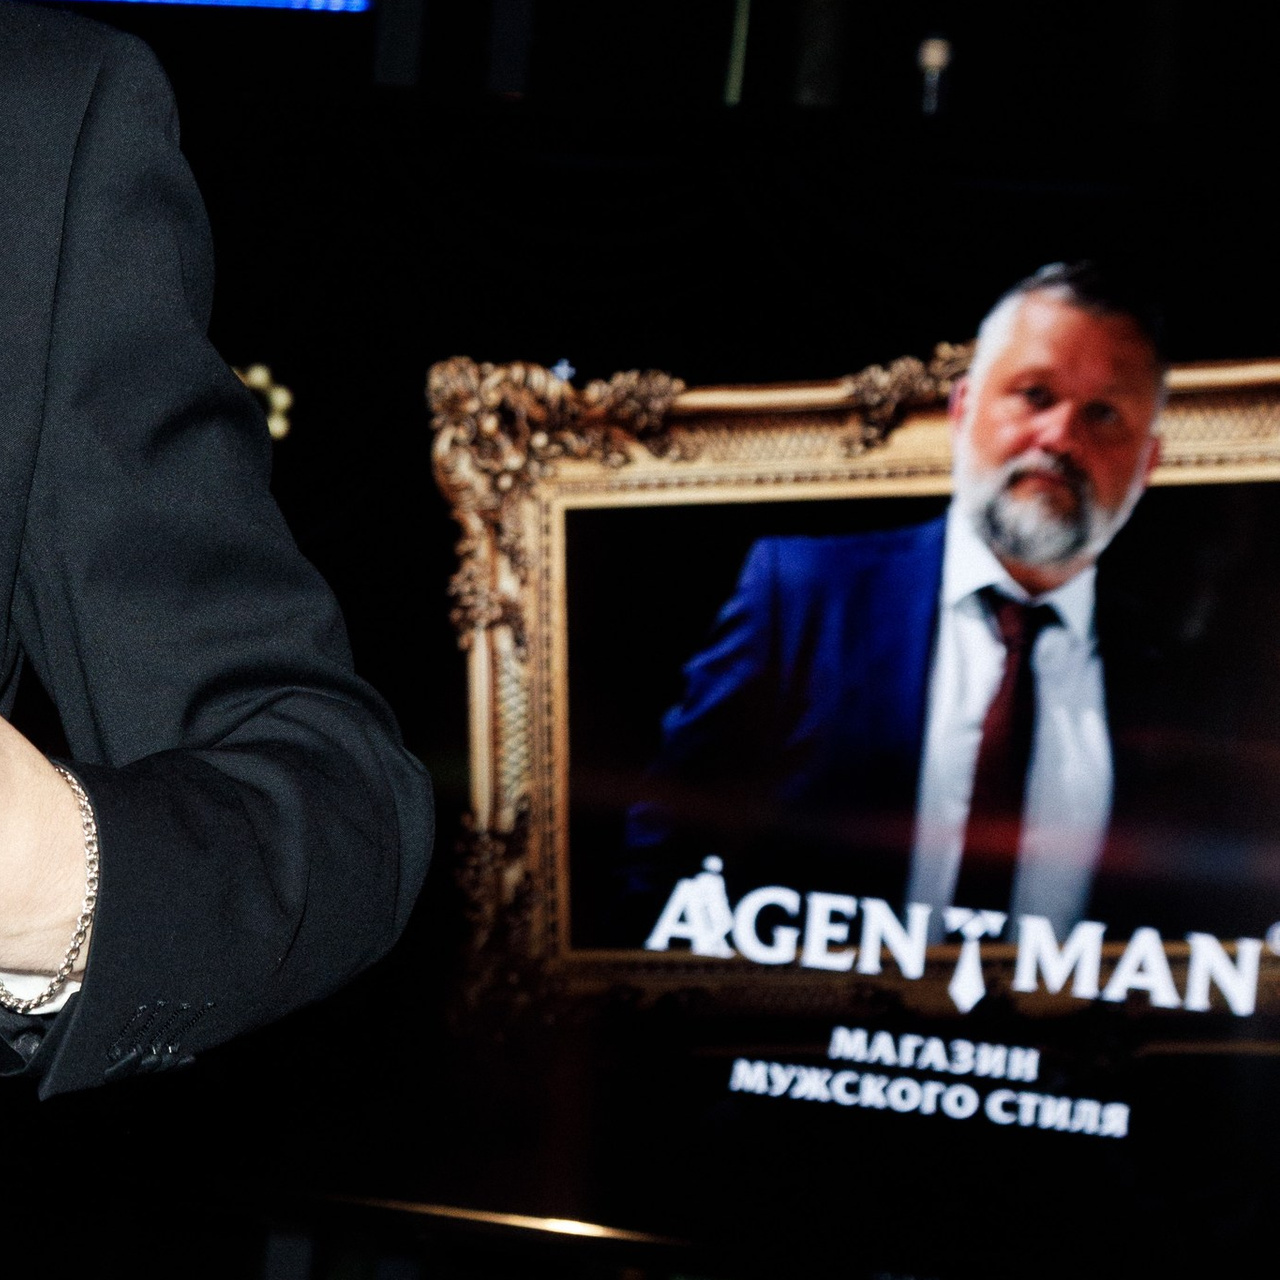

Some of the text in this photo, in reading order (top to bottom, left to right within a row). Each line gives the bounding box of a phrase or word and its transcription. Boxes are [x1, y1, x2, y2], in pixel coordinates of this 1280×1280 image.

[828, 1026, 1040, 1082] МАГАЗИН
[729, 1058, 1130, 1138] МУЖСКОГО СТИЛЯ
